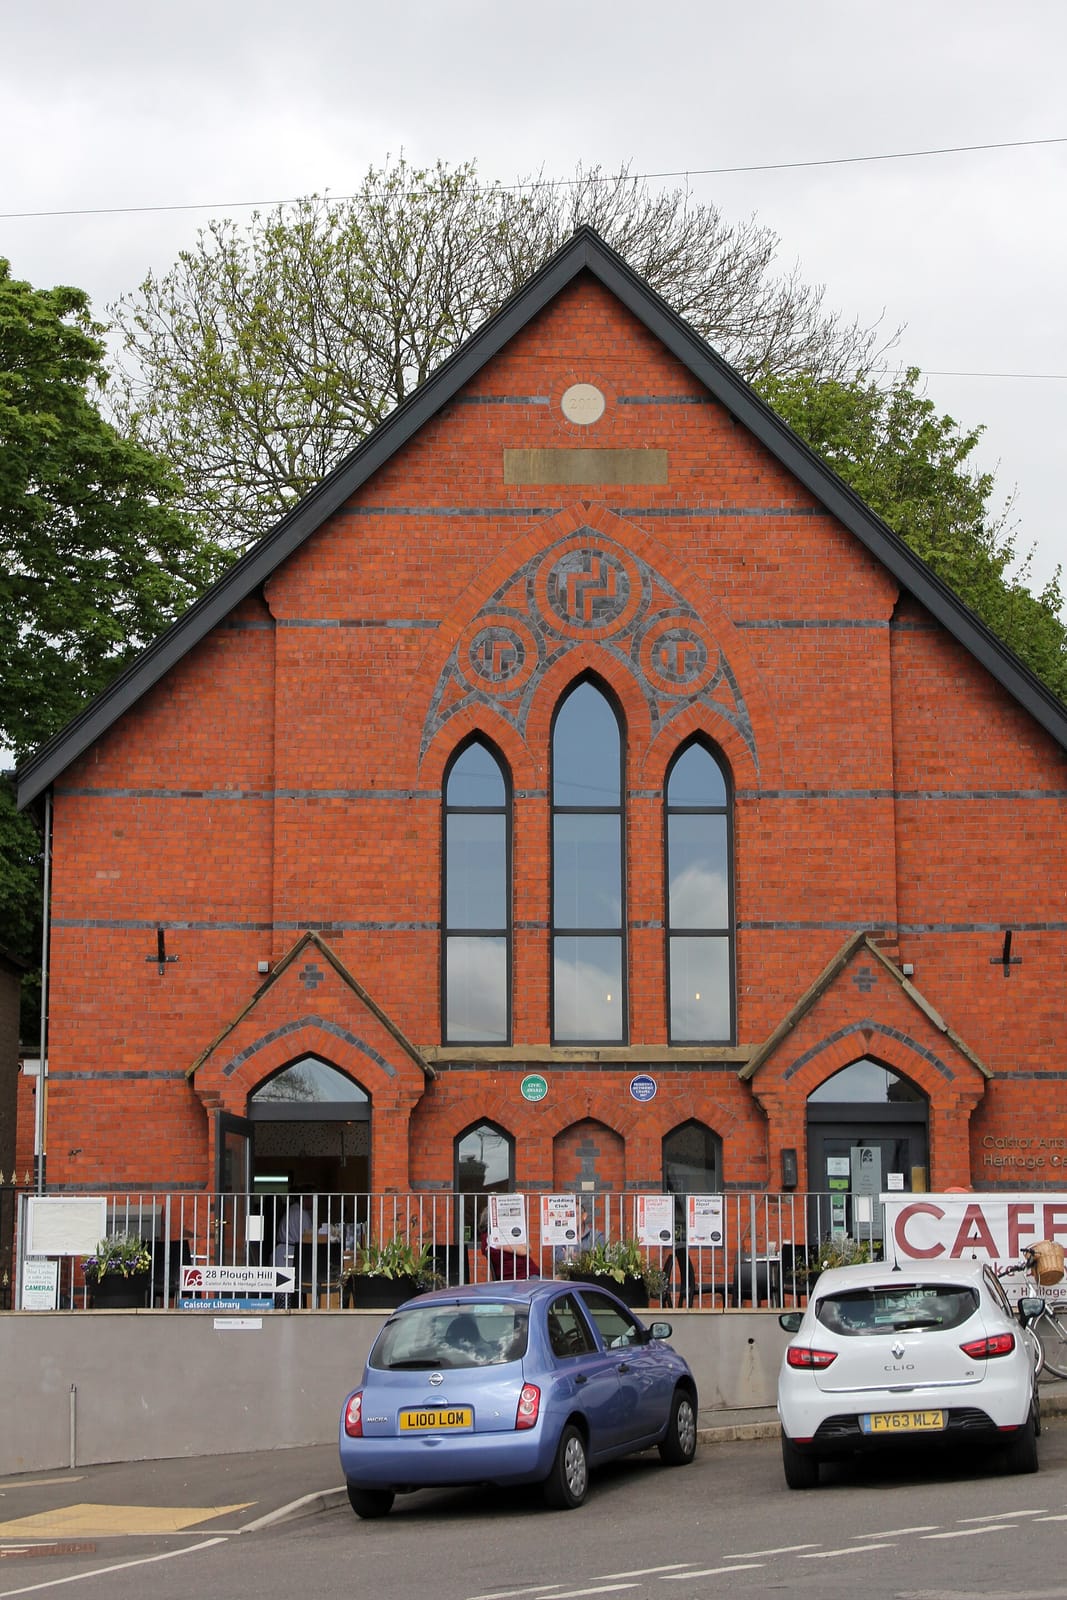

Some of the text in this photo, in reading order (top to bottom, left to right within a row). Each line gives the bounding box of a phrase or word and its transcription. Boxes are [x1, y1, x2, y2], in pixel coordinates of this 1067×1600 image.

[983, 1135, 1065, 1149] Caistor Arts
[983, 1153, 1045, 1169] Heritage
[205, 1270, 273, 1281] 28 Plough Hill
[184, 1301, 240, 1309] Caistor Library
[884, 1364, 915, 1372] CLIO
[407, 1411, 464, 1427] L100 LOM
[873, 1413, 910, 1429] FY63
[913, 1412, 941, 1427] MLZ
